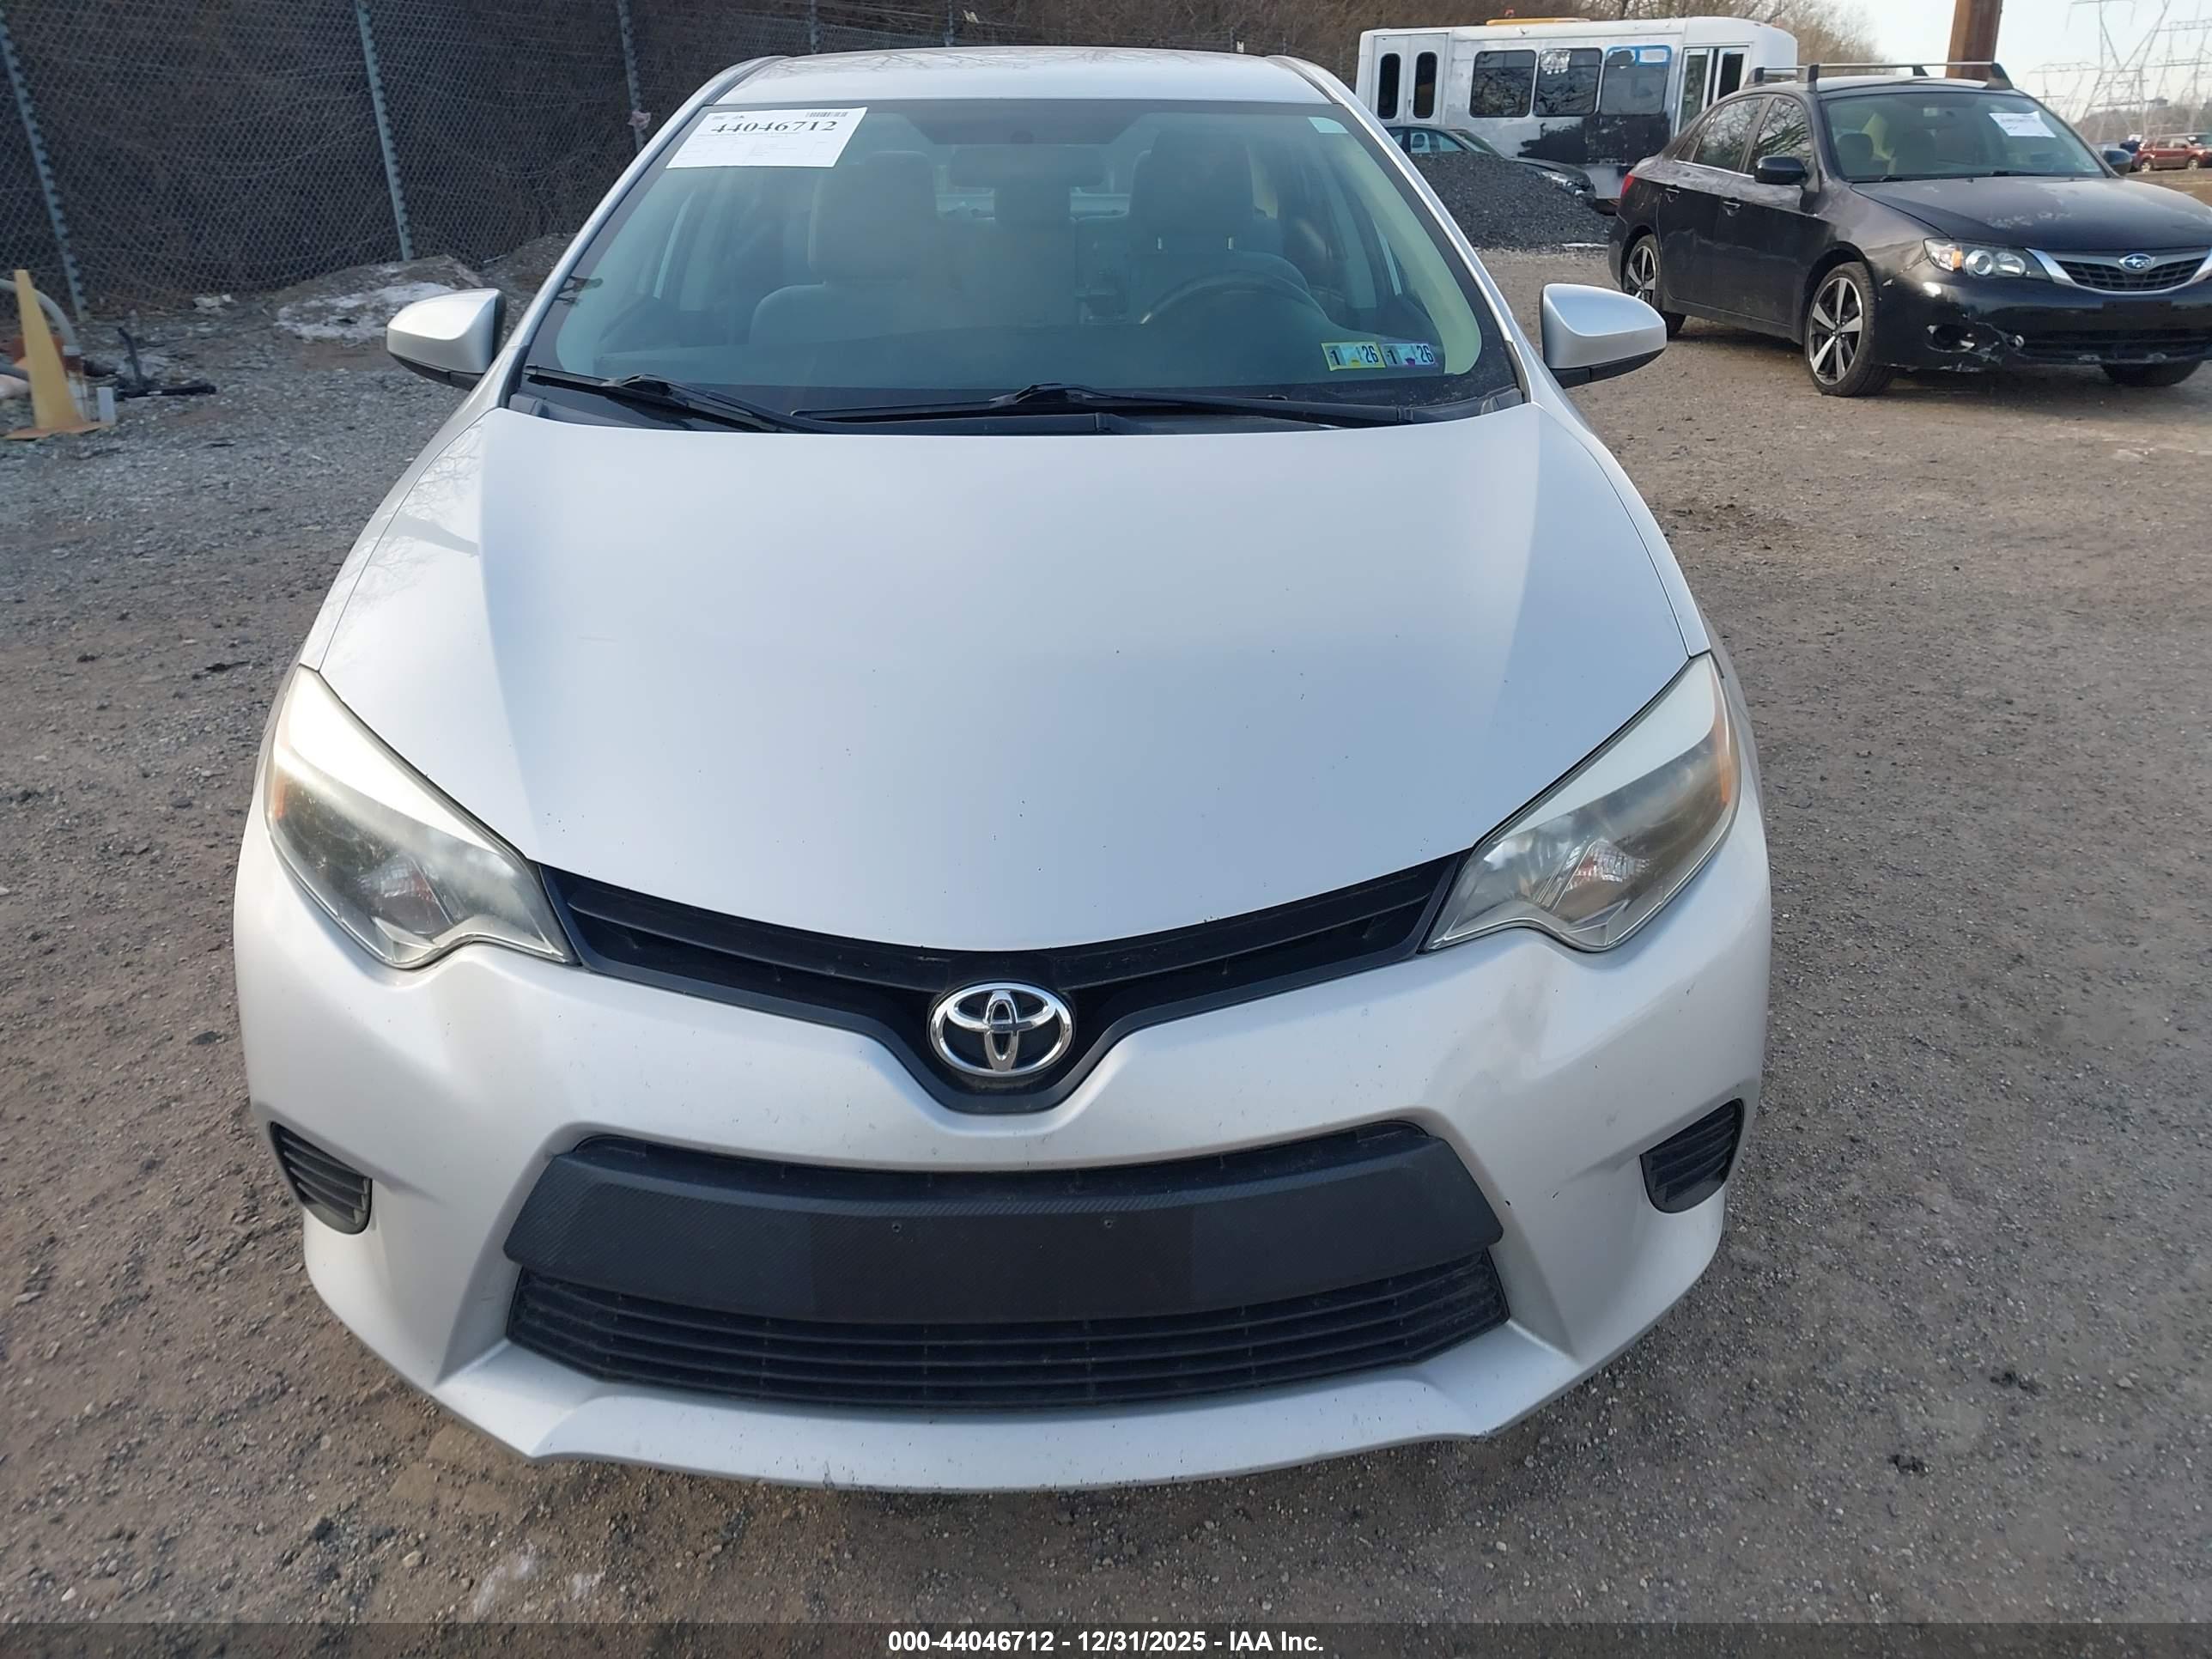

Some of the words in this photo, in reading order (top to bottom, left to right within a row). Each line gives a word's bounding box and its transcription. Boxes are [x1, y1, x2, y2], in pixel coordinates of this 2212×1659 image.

[711, 120, 838, 133] 44046712
[1330, 349, 1340, 366] 1
[1361, 345, 1379, 363] 26
[1387, 349, 1398, 365] 1
[1416, 345, 1434, 363] 26
